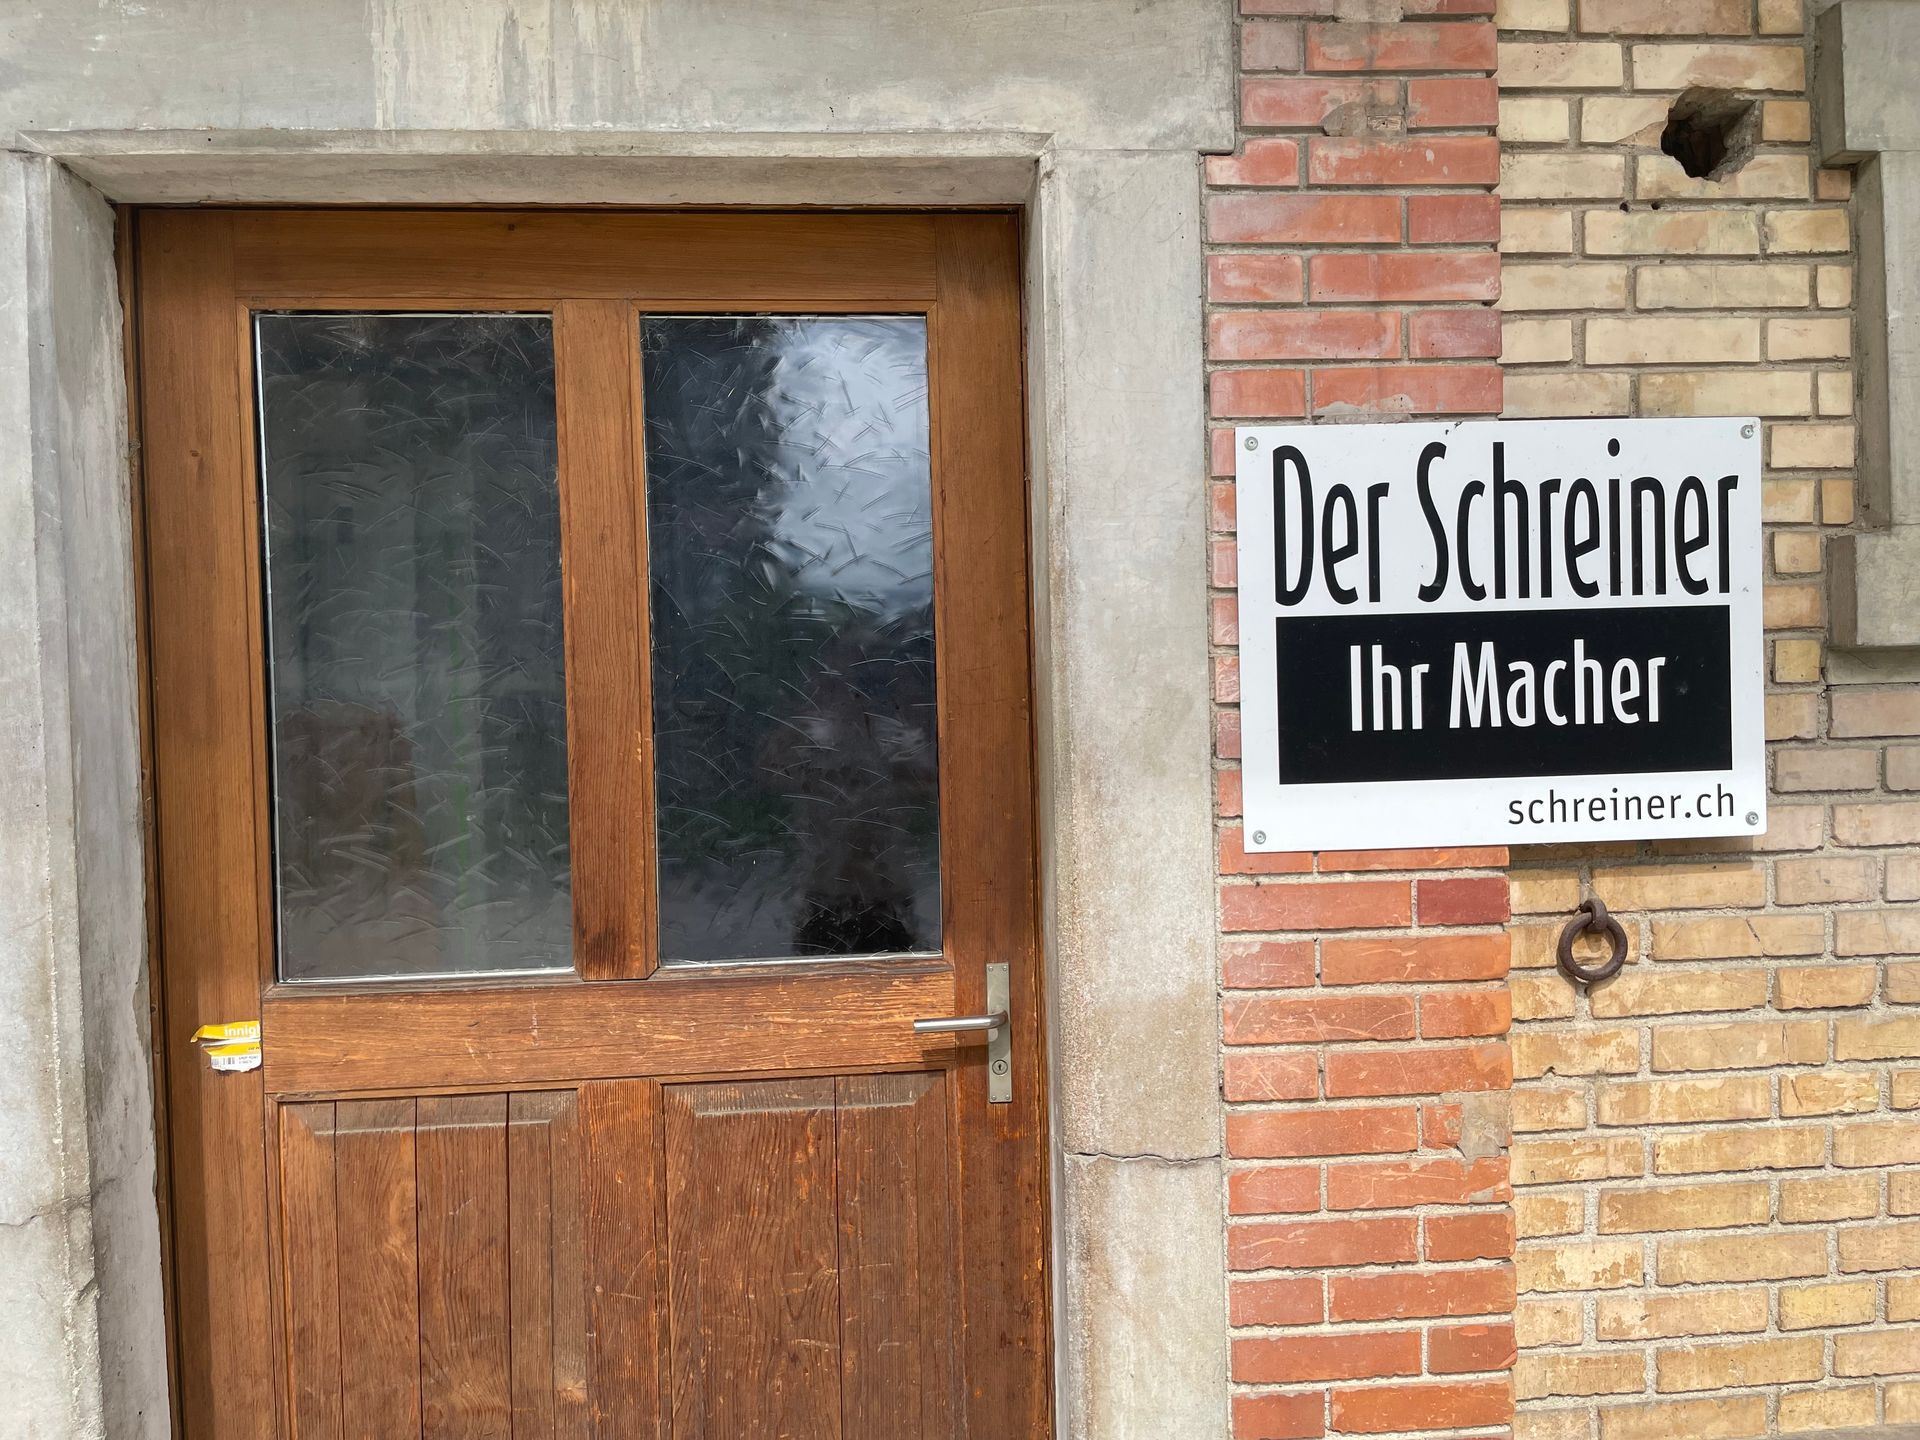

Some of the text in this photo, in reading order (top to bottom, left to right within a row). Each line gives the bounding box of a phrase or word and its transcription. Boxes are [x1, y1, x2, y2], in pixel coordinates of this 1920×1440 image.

[1272, 438, 1740, 607] Der Schreiner
[1350, 638, 1667, 732] Ihr Macher
[1508, 784, 1735, 825] schreiner.ch
